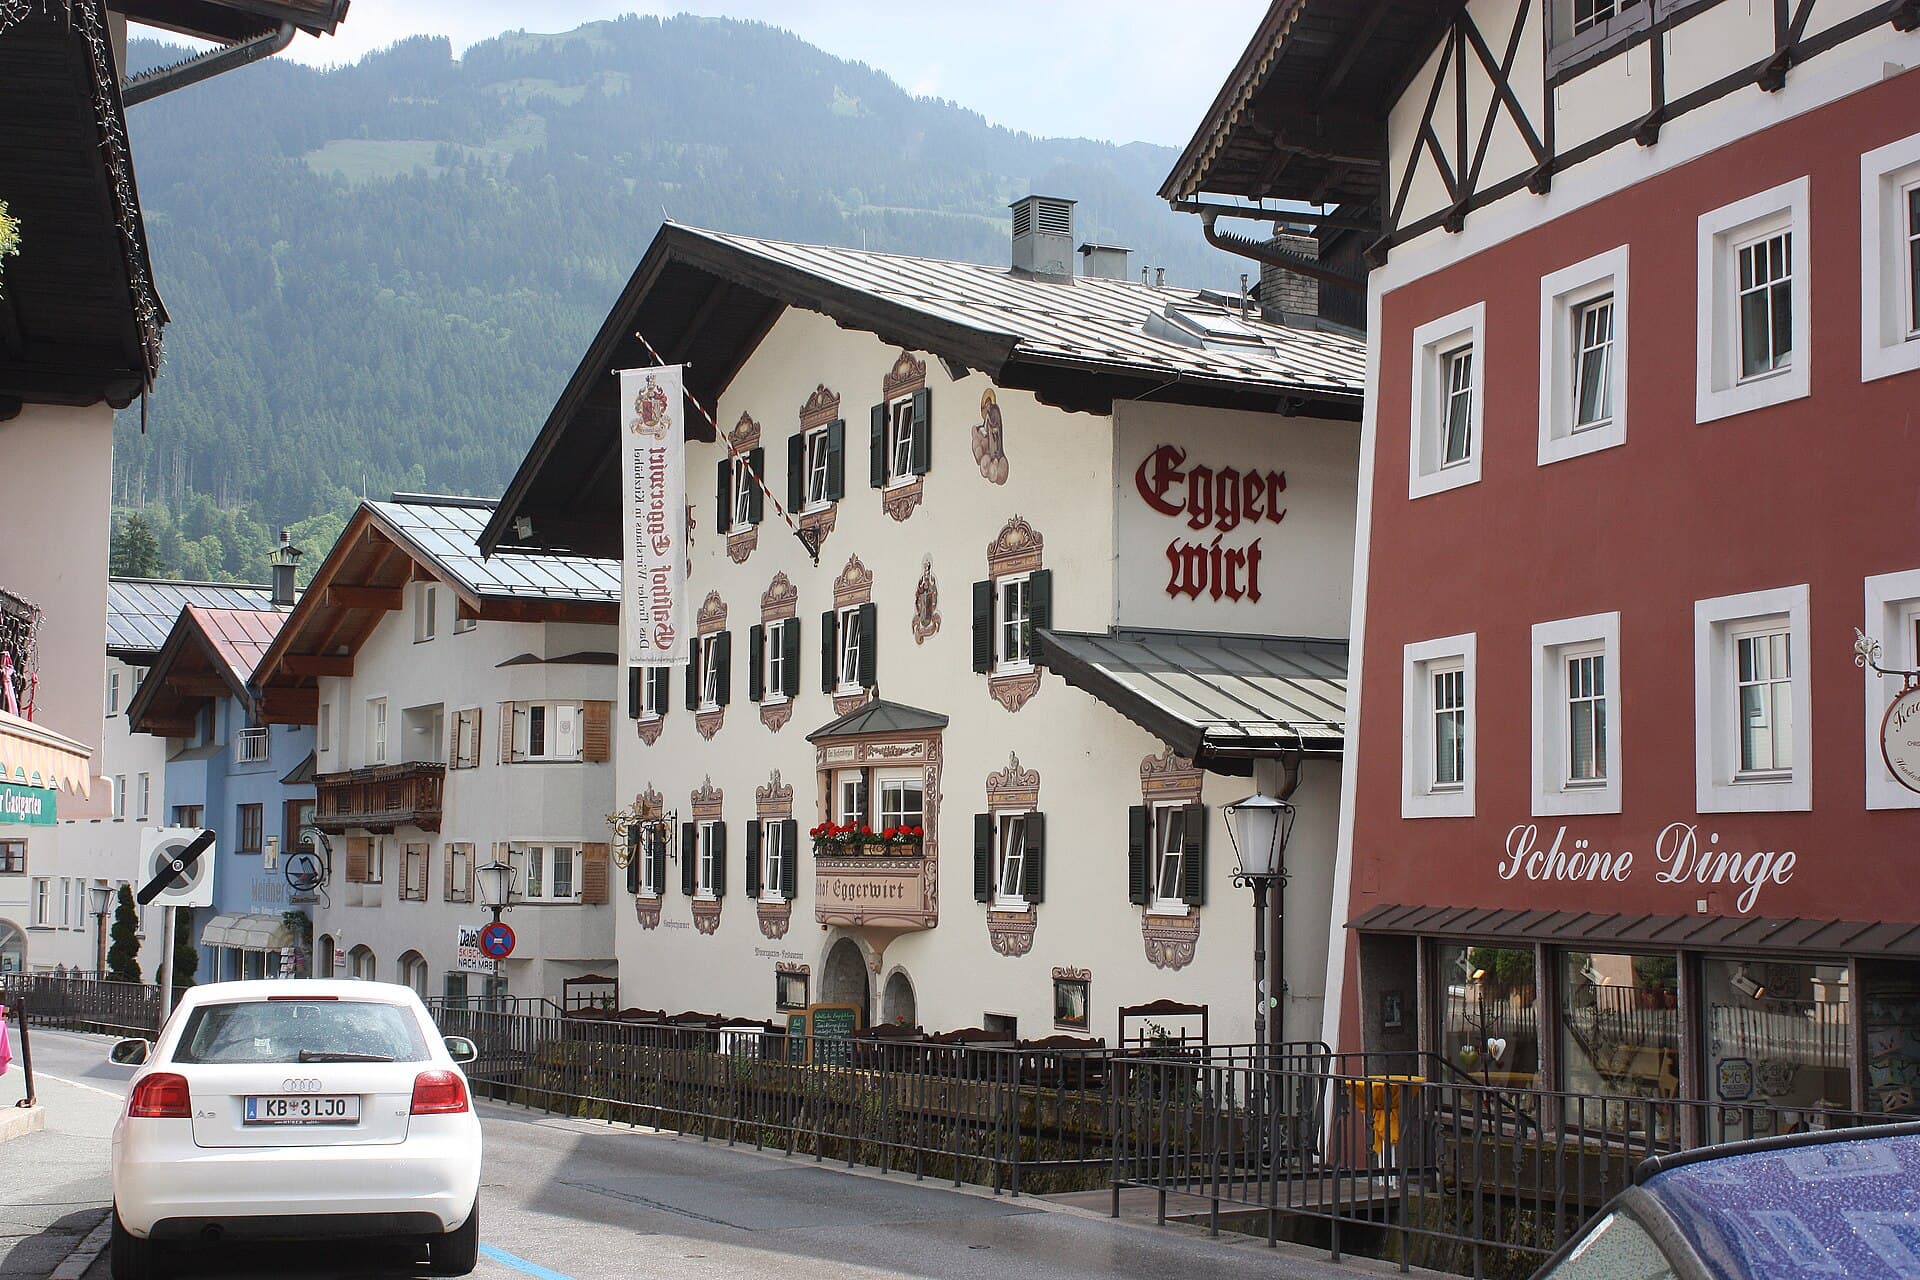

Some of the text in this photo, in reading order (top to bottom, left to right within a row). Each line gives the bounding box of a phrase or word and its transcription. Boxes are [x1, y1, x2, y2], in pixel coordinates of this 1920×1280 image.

[1135, 444, 1287, 532] Egger
[1165, 533, 1262, 604] wirt
[5, 788, 42, 820] Gastgarten
[1498, 822, 1797, 913] Schöne Dinge
[833, 878, 905, 901] Eggerwirt
[458, 958, 477, 969] NACH
[266, 1099, 287, 1116] KB
